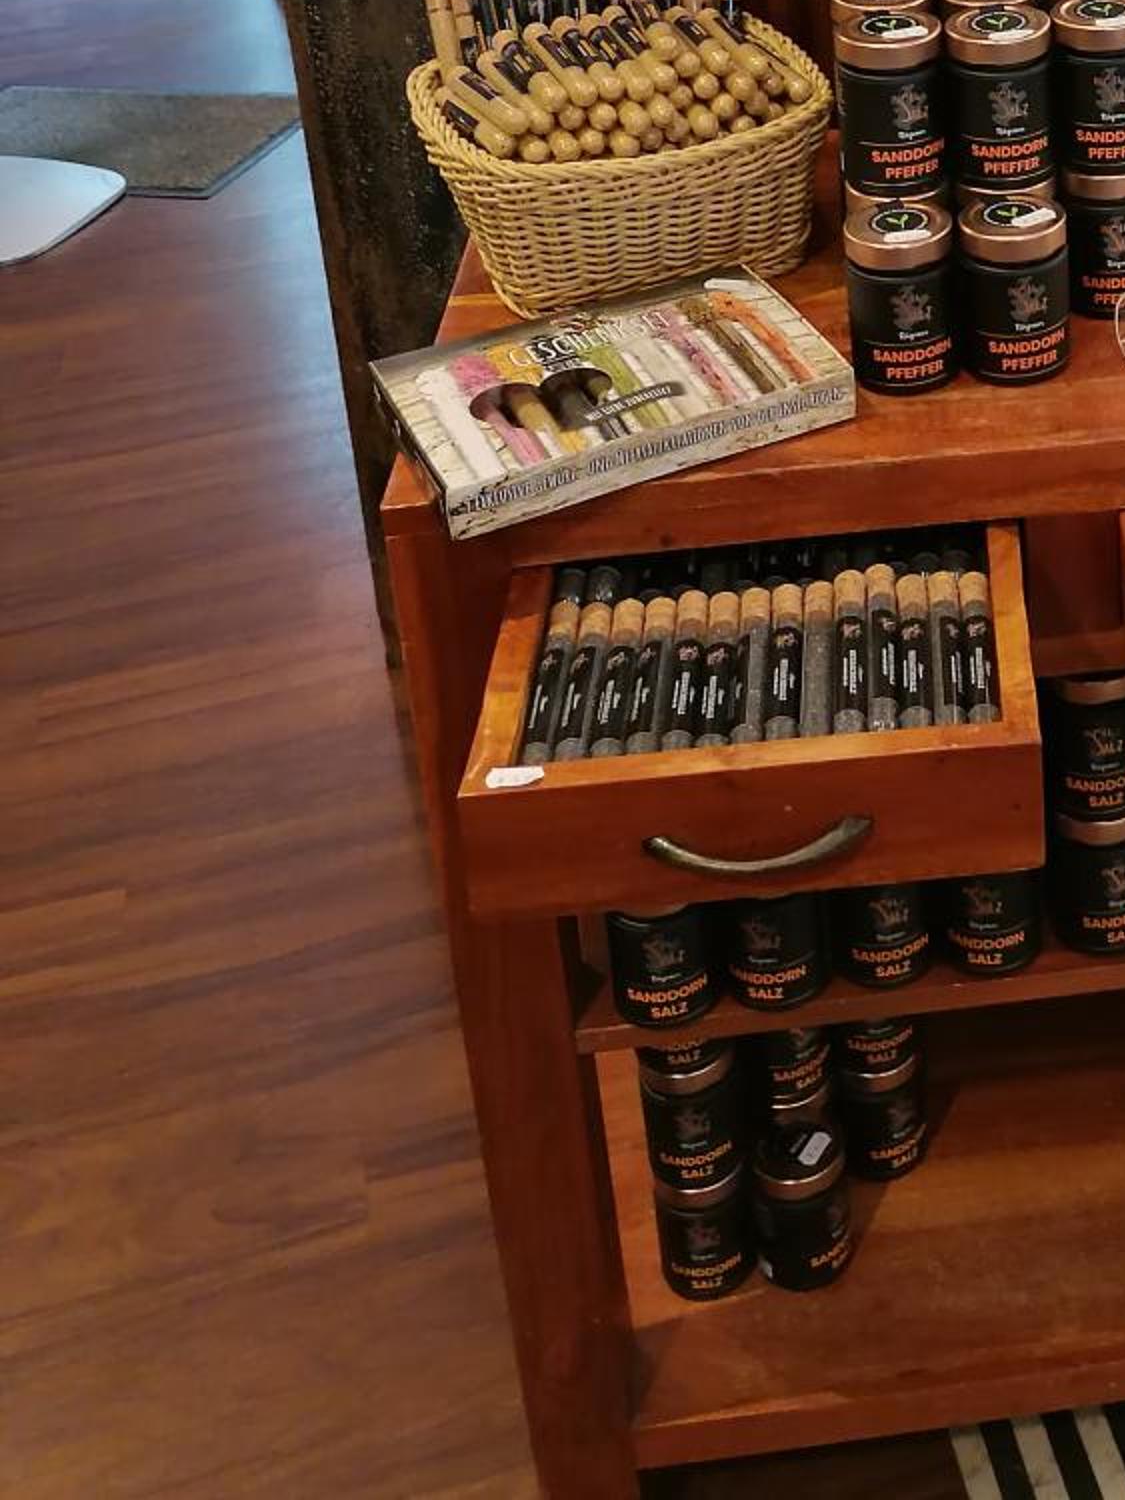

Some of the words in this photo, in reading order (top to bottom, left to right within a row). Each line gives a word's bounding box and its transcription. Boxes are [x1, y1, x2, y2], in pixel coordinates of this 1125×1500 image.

[971, 135, 1049, 159] SANDDORN
[885, 158, 939, 180] PFEFFER
[983, 155, 1041, 175] PFEFFER
[988, 327, 1066, 356] SANDDORN
[886, 360, 944, 380] PFEFFER
[1001, 350, 1057, 371] PFEFFER
[1088, 792, 1125, 807] SALZ
[967, 952, 1003, 966] SALZ
[875, 961, 912, 978] SALZ
[627, 974, 708, 1004] SANDDORN
[746, 987, 784, 999] SALZ
[650, 1002, 689, 1019] SALZ
[680, 1164, 714, 1180] SALZ
